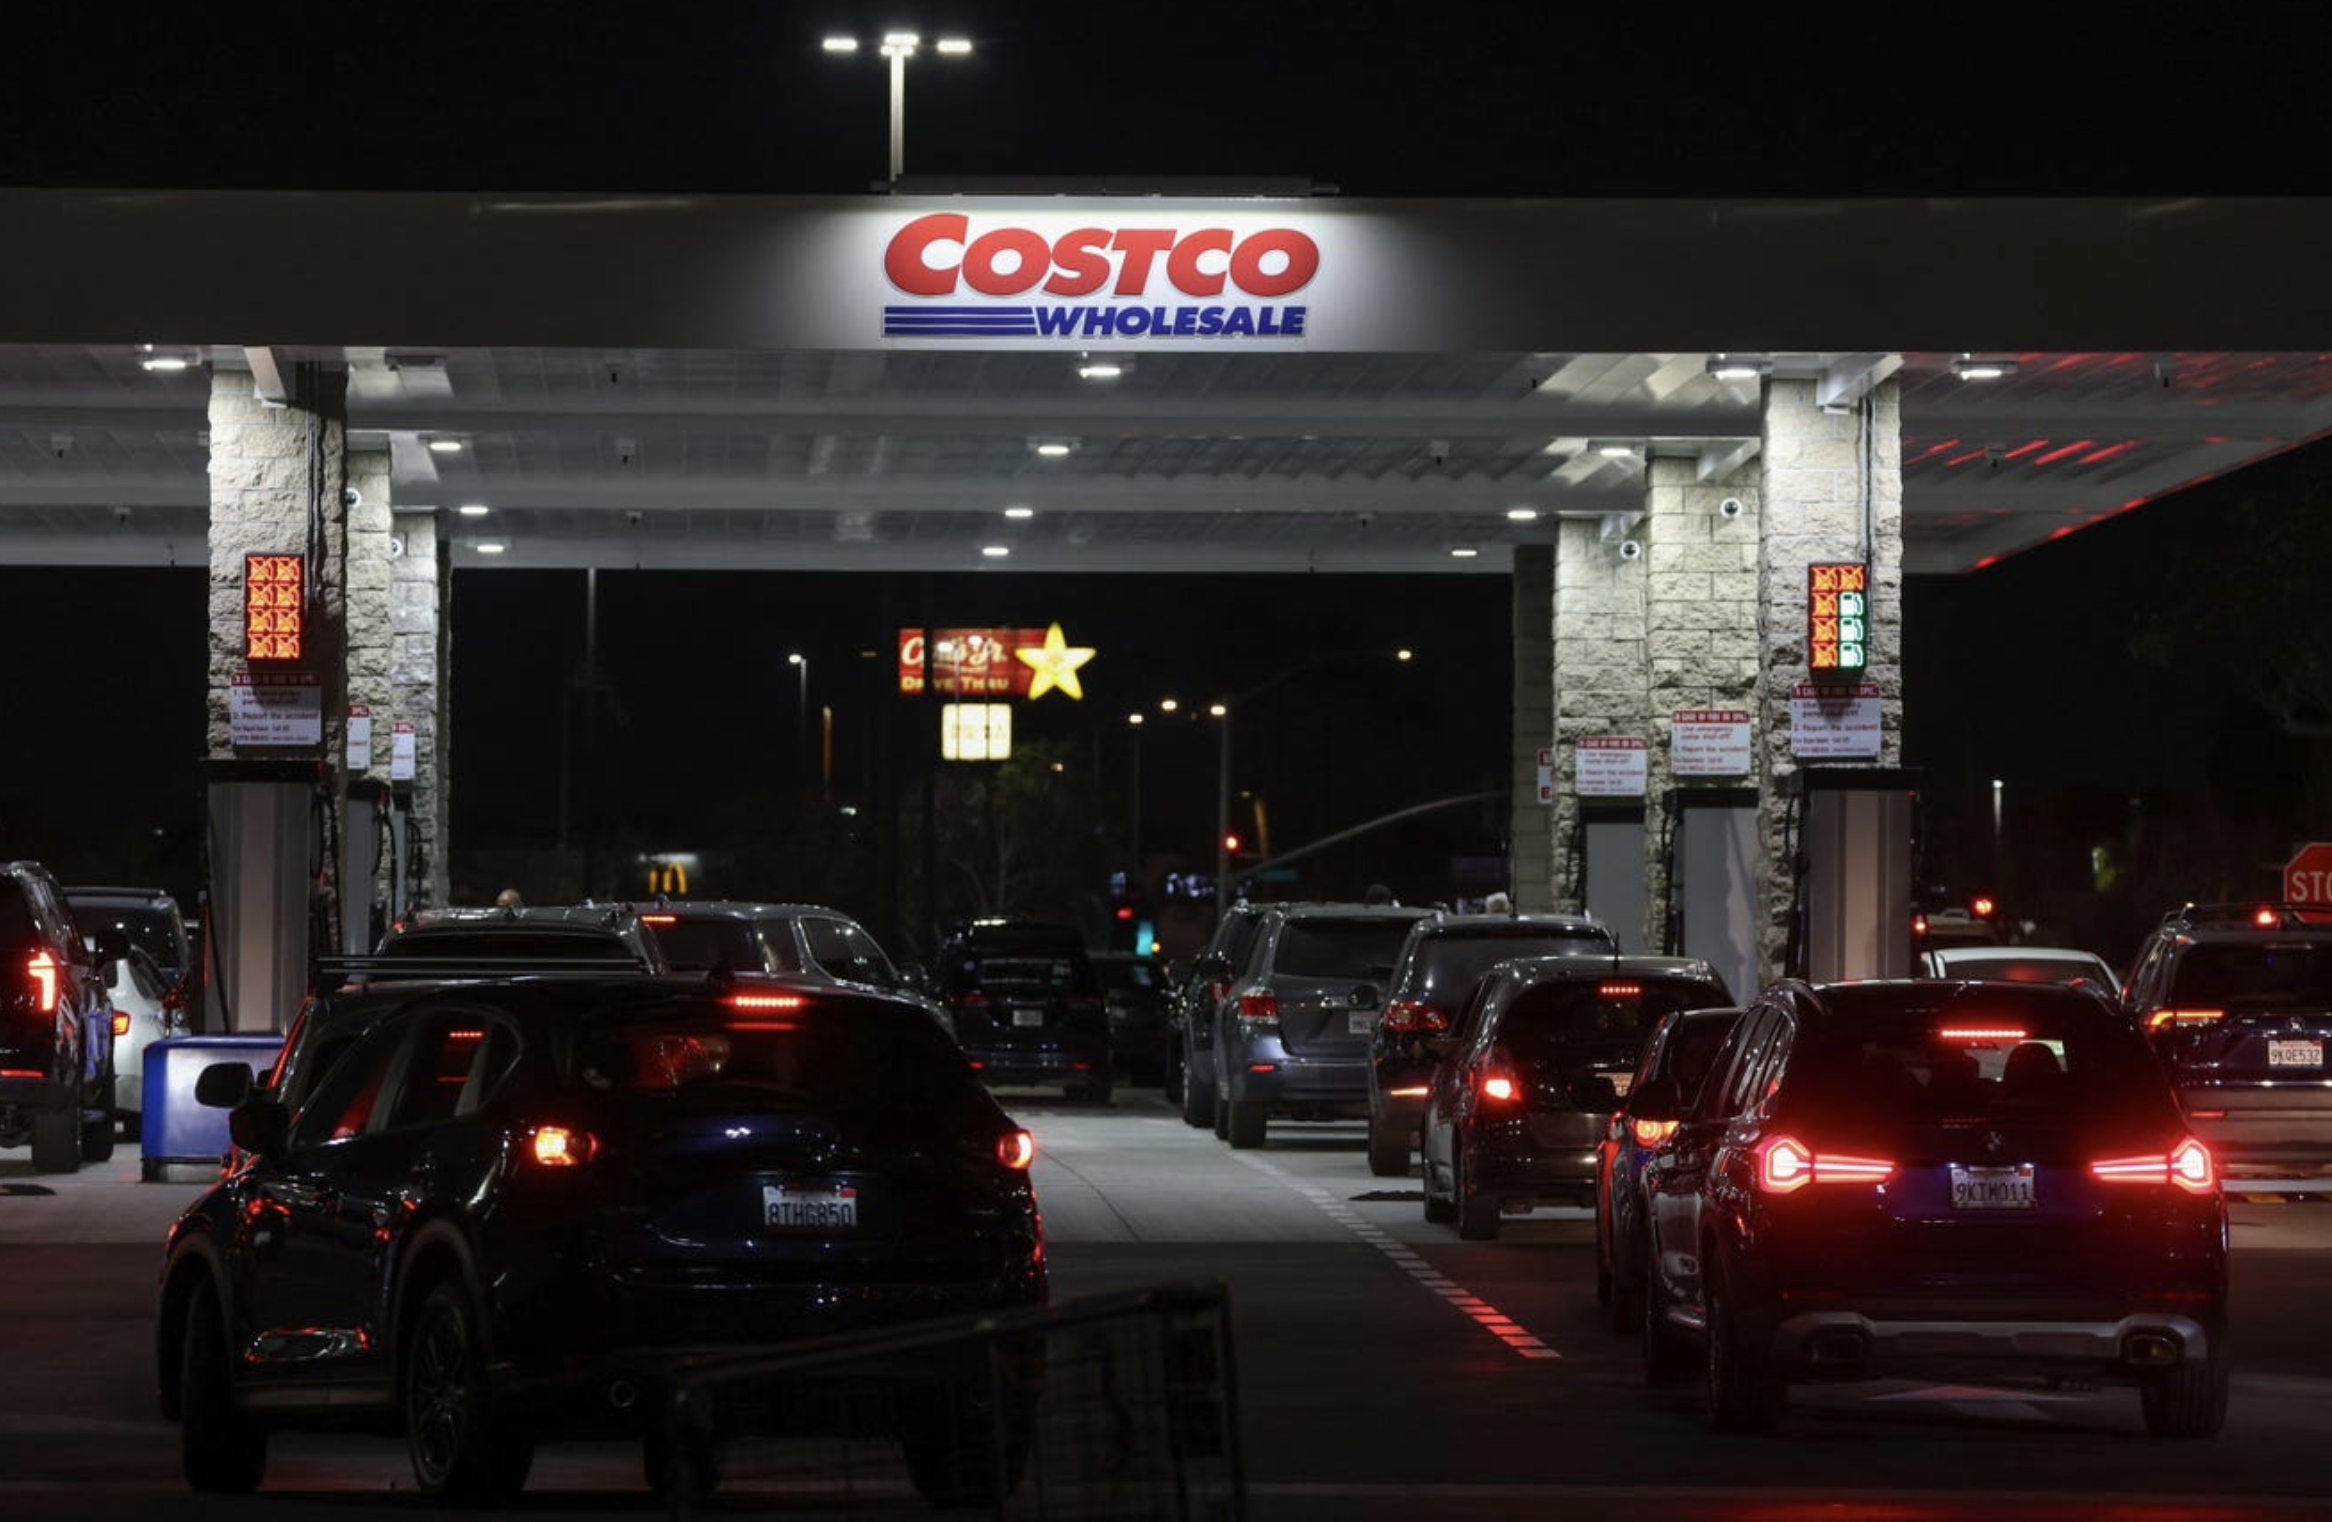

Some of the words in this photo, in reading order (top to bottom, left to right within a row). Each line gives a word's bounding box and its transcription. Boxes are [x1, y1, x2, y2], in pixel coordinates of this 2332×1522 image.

[884, 212, 1320, 297] COSTCO
[1036, 306, 1307, 337] WHOLESALE
[768, 1202, 852, 1227] 8THG850
